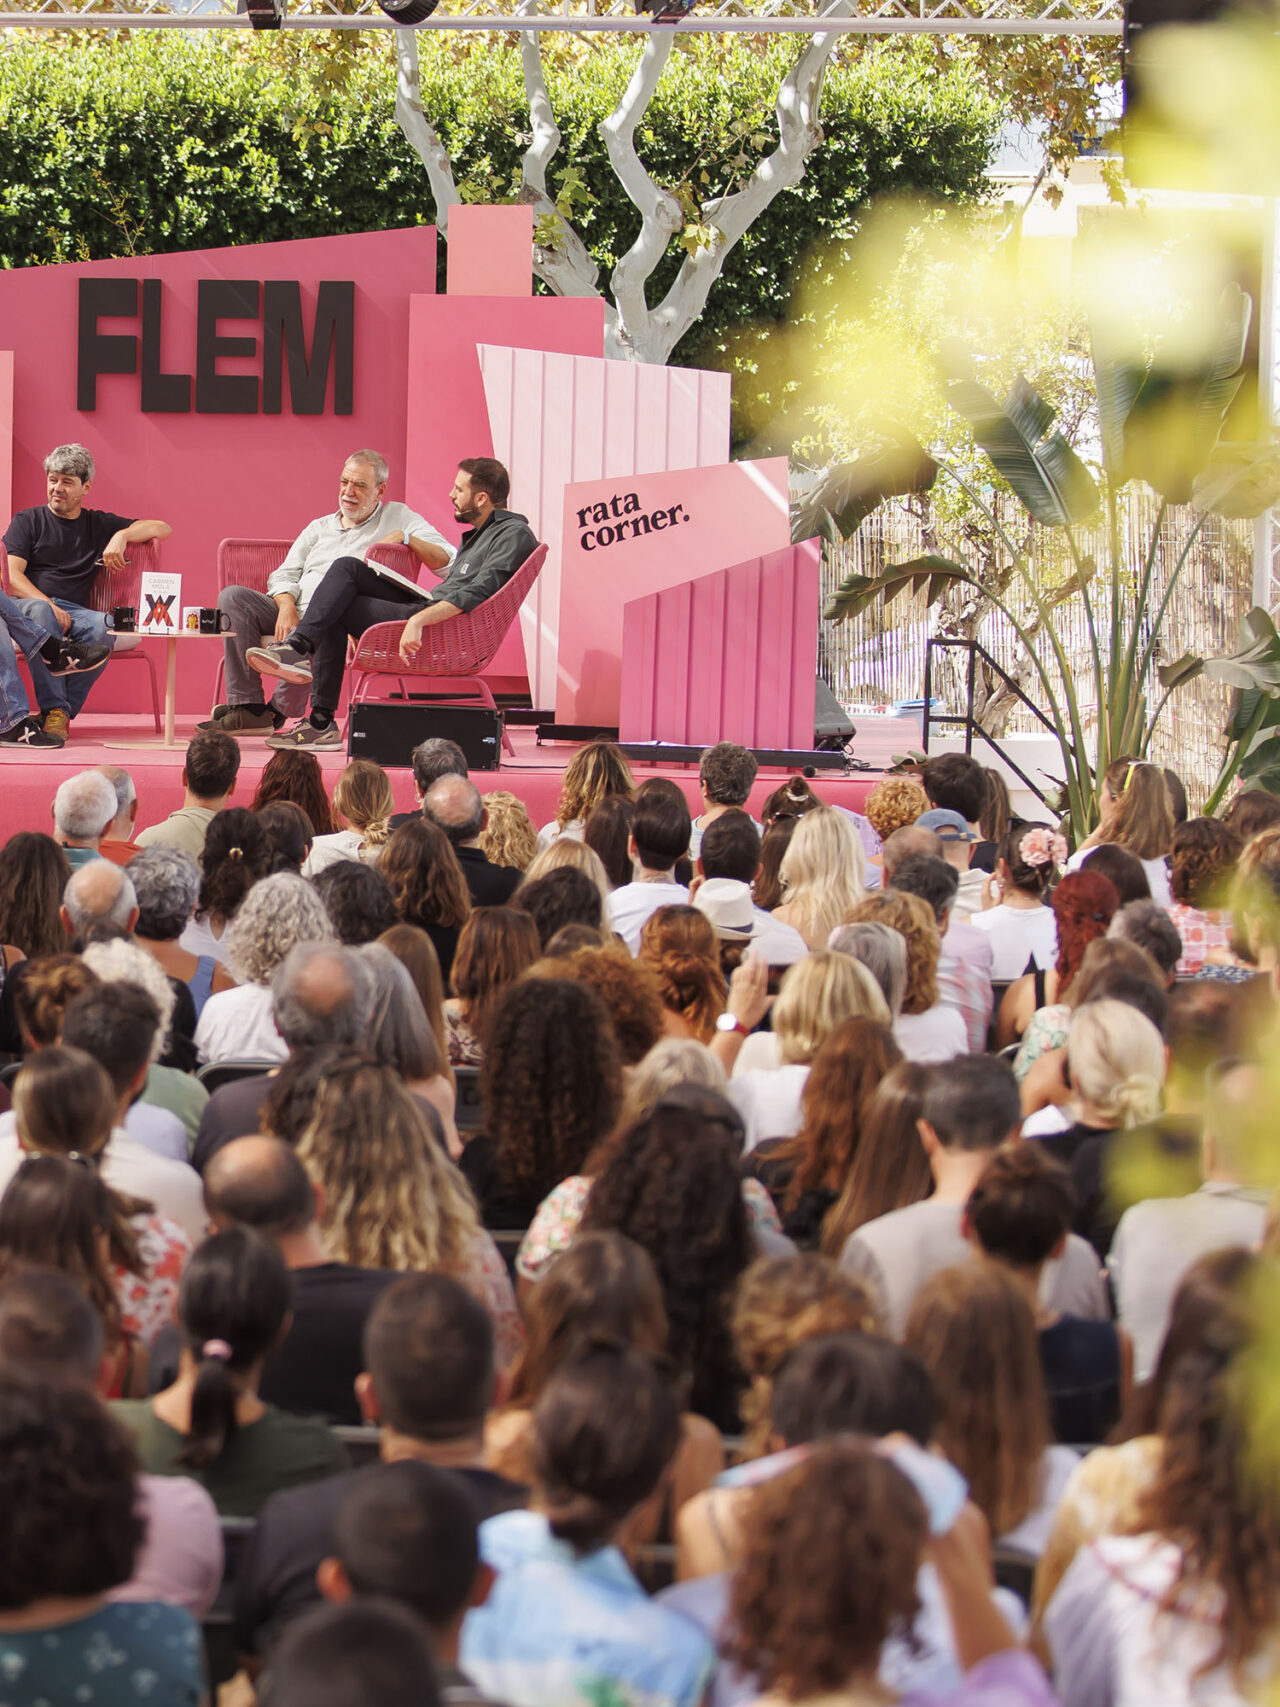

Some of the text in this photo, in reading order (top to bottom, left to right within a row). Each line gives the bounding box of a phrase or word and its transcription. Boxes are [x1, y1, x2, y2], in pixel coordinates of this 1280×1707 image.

[77, 277, 355, 415] FLEM
[576, 492, 642, 529] rata
[580, 503, 691, 552] corner.
